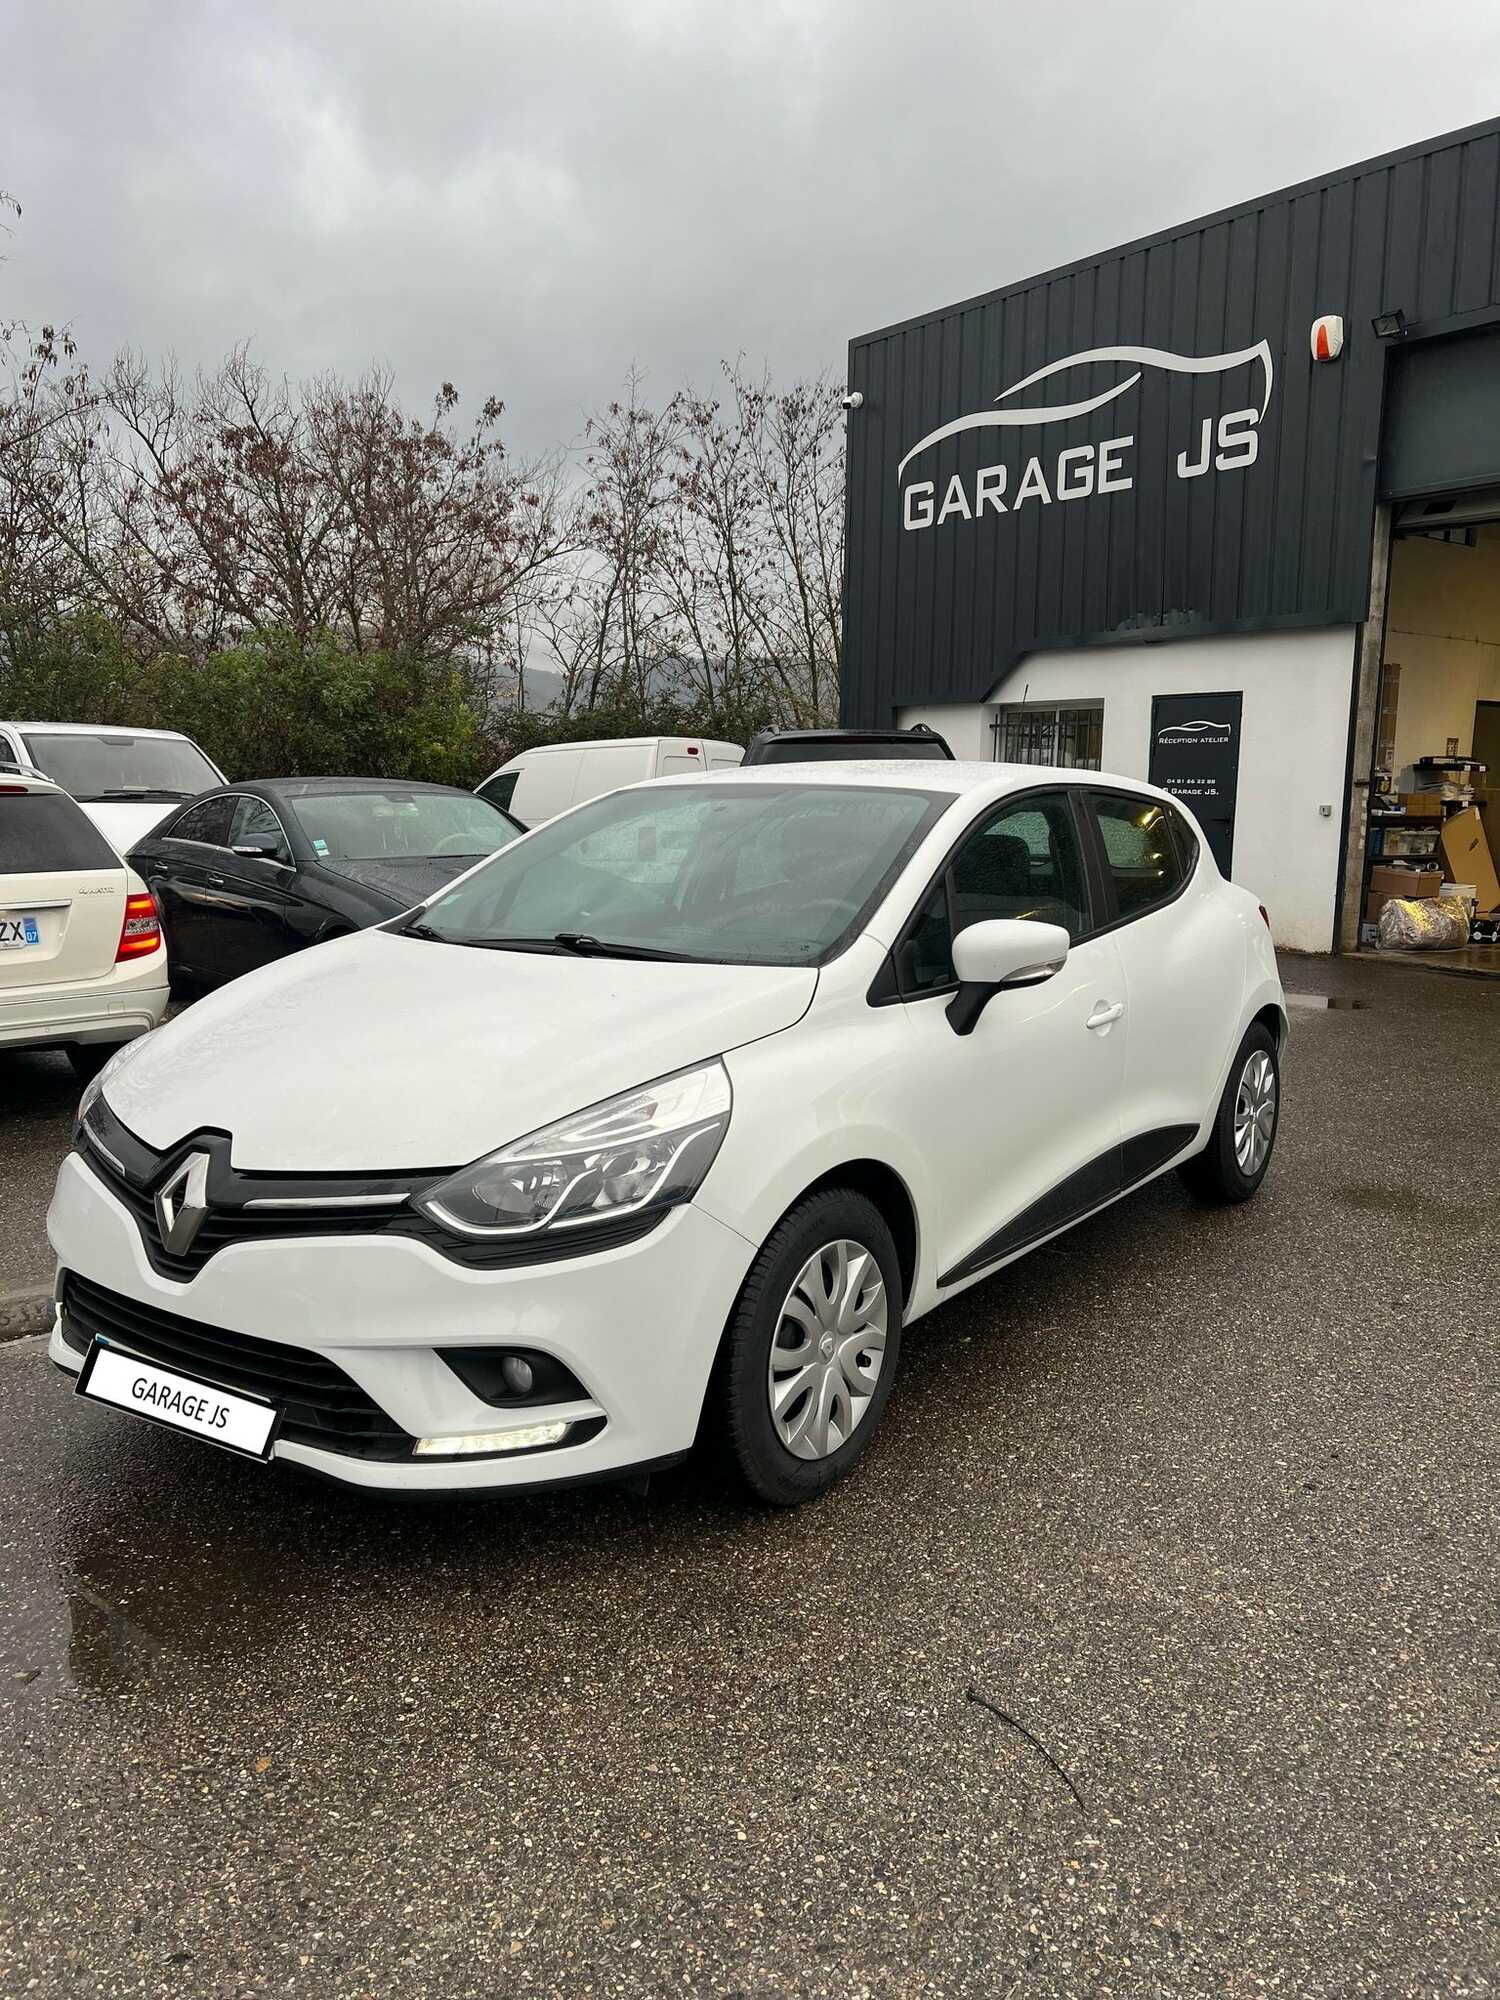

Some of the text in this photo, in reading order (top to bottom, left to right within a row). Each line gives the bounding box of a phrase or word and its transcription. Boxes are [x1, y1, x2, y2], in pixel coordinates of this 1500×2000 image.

[903, 407, 1260, 531] GARAGE JS
[1171, 787, 1202, 795] GARAGE
[26, 931, 37, 942] 07
